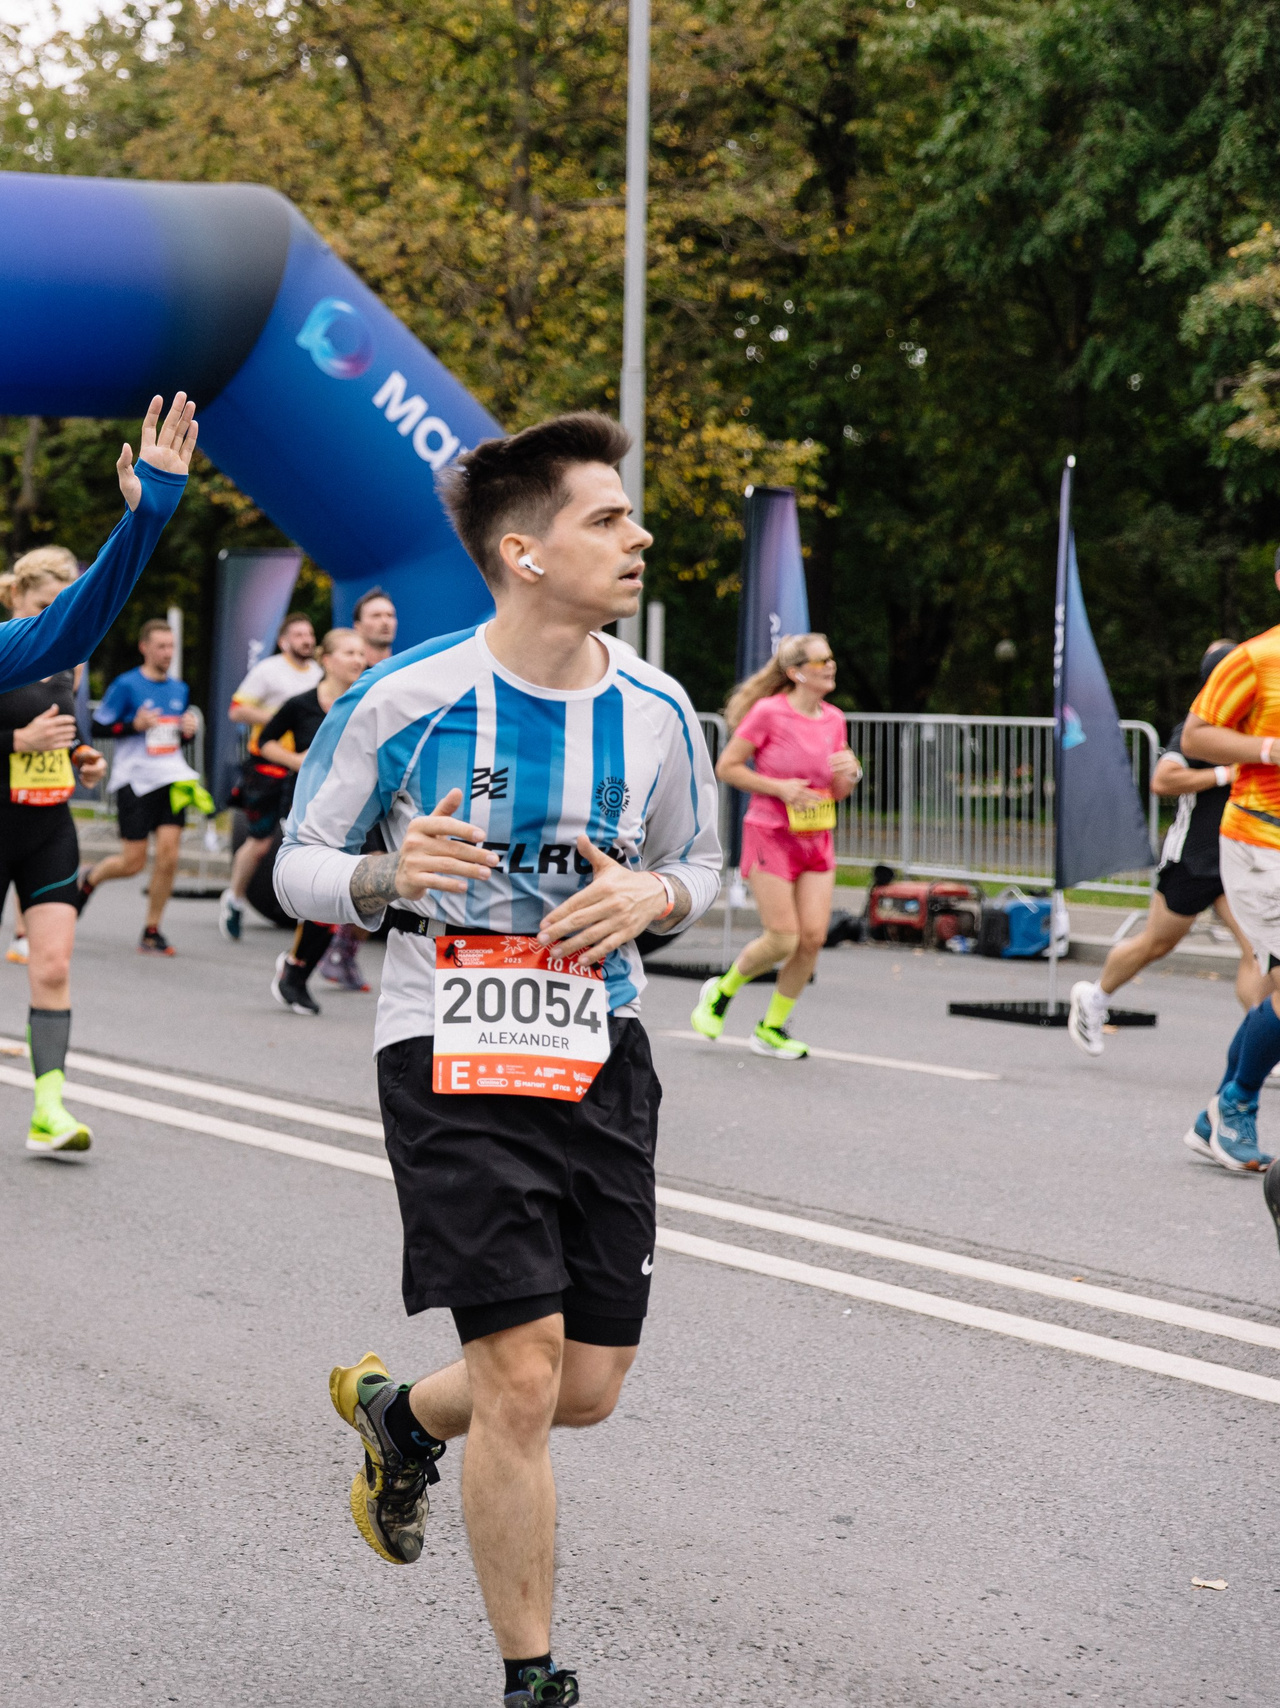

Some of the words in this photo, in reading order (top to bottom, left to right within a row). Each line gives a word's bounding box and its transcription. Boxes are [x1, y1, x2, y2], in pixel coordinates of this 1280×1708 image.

[546, 957, 564, 972] 10
[442, 977, 602, 1034] 20054
[477, 1031, 570, 1050] ALEXANDER
[451, 1060, 471, 1090] E
